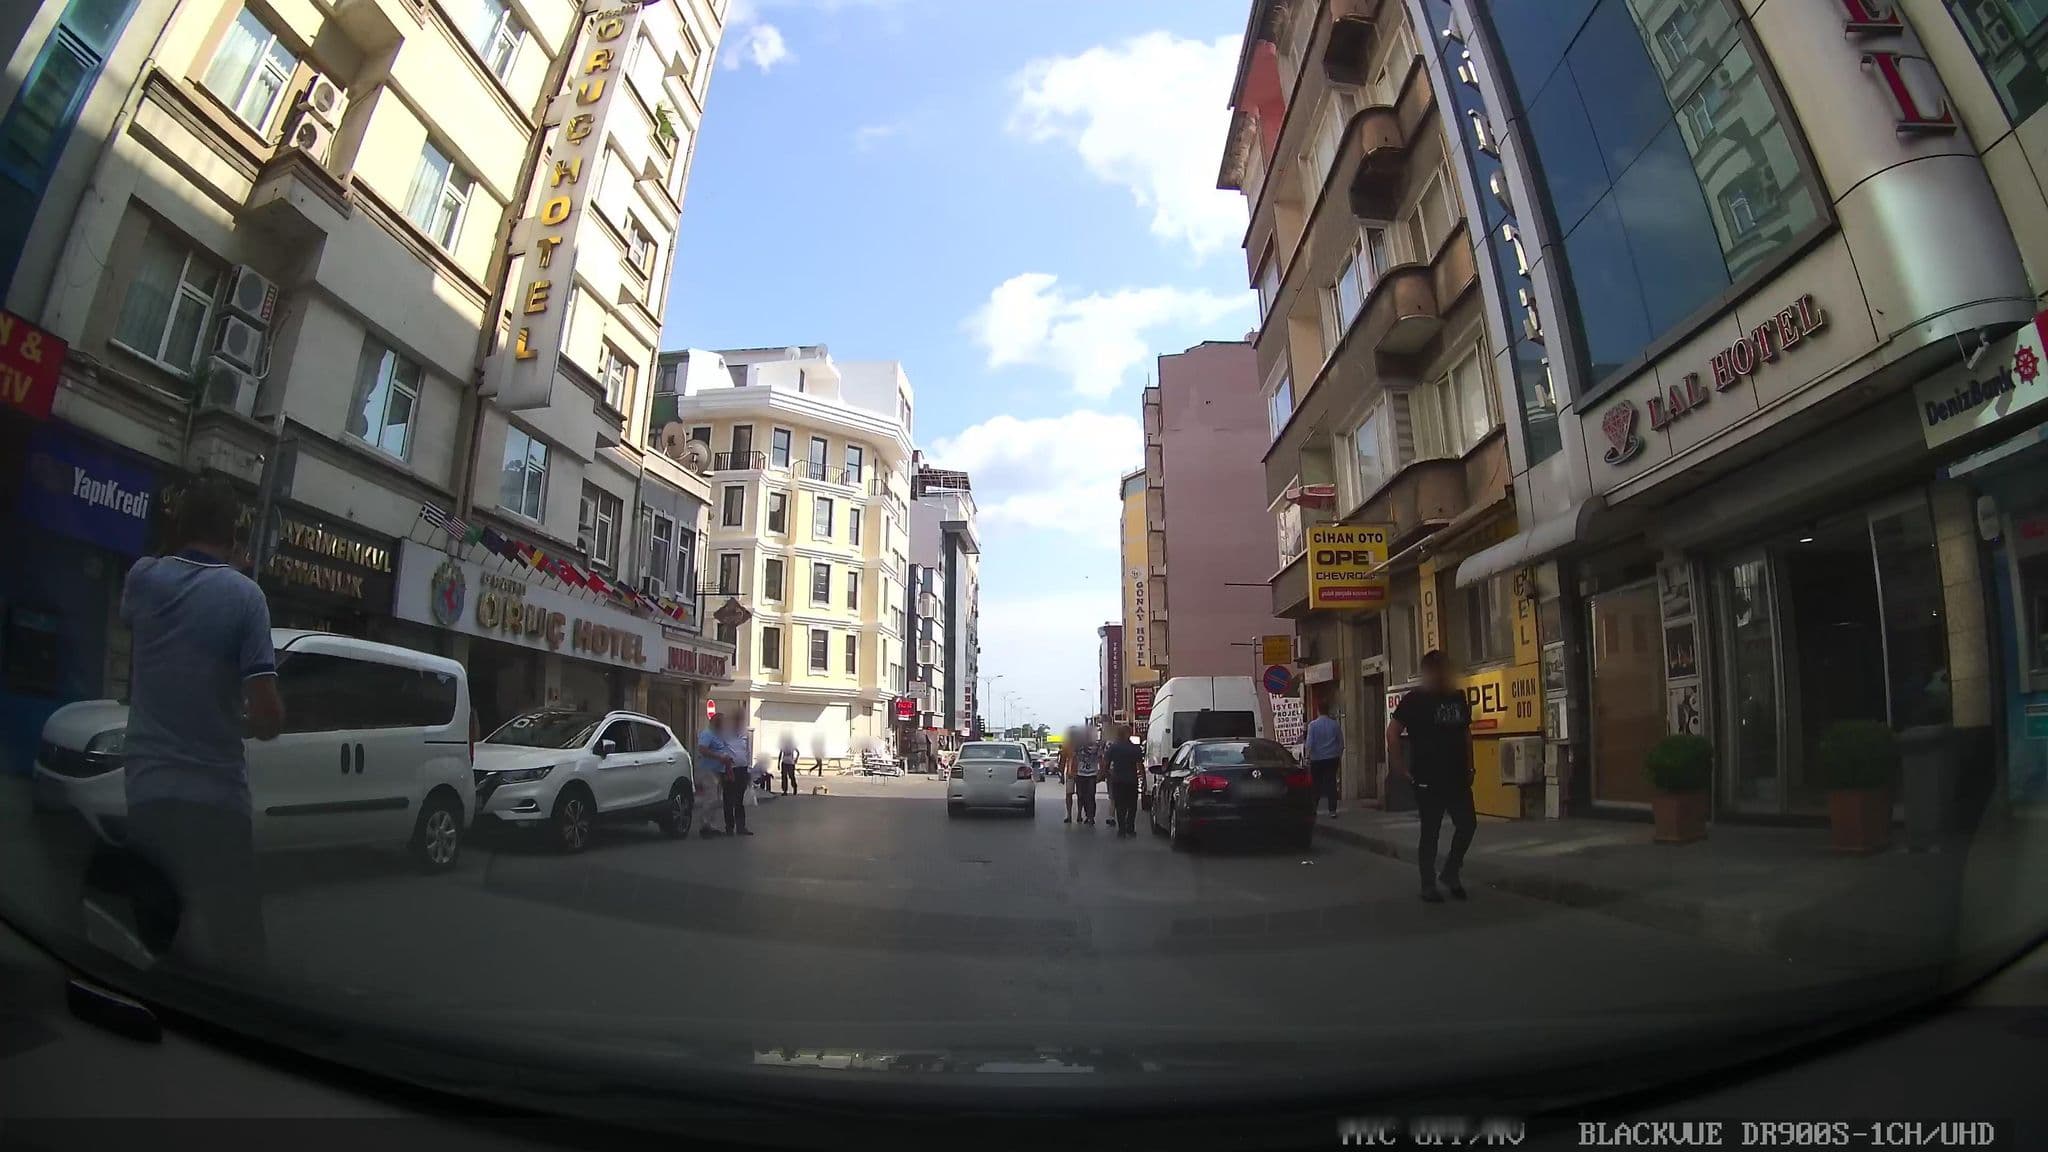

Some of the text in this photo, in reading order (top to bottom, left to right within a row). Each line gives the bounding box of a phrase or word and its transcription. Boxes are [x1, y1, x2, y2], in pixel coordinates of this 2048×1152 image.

[515, 157, 582, 362] HOTEL
[1647, 293, 1825, 431] LAL HOTEL
[1925, 366, 2016, 427] DenizBank
[1313, 531, 1384, 544] CİHAN OTO
[573, 616, 648, 666] HOTEL
[1425, 591, 1436, 649] OPE
[1462, 682, 1509, 716] PEL
[1517, 700, 1532, 718] OTO
